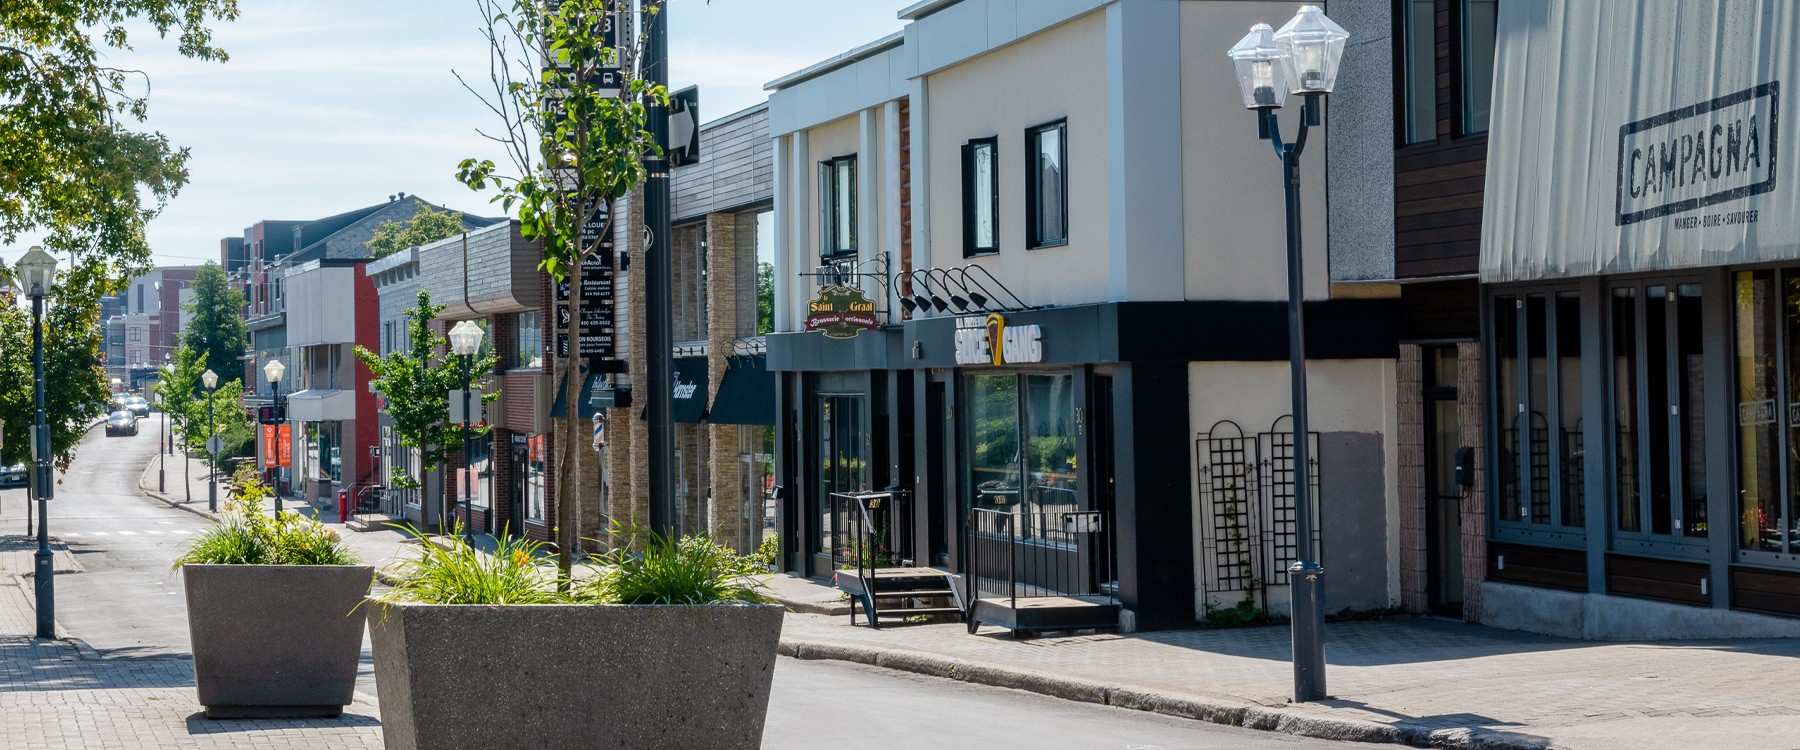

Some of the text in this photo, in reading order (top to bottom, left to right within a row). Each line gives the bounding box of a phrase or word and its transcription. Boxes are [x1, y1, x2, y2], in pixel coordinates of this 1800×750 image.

[1630, 115, 1761, 198] CAMPAGNA
[1674, 210, 1759, 230] MANGER BOIRE SAVOURER
[810, 301, 873, 312] Saint Graal
[810, 316, 874, 327] Brasserie artisanale
[955, 325, 1042, 365] SLICE GANG
